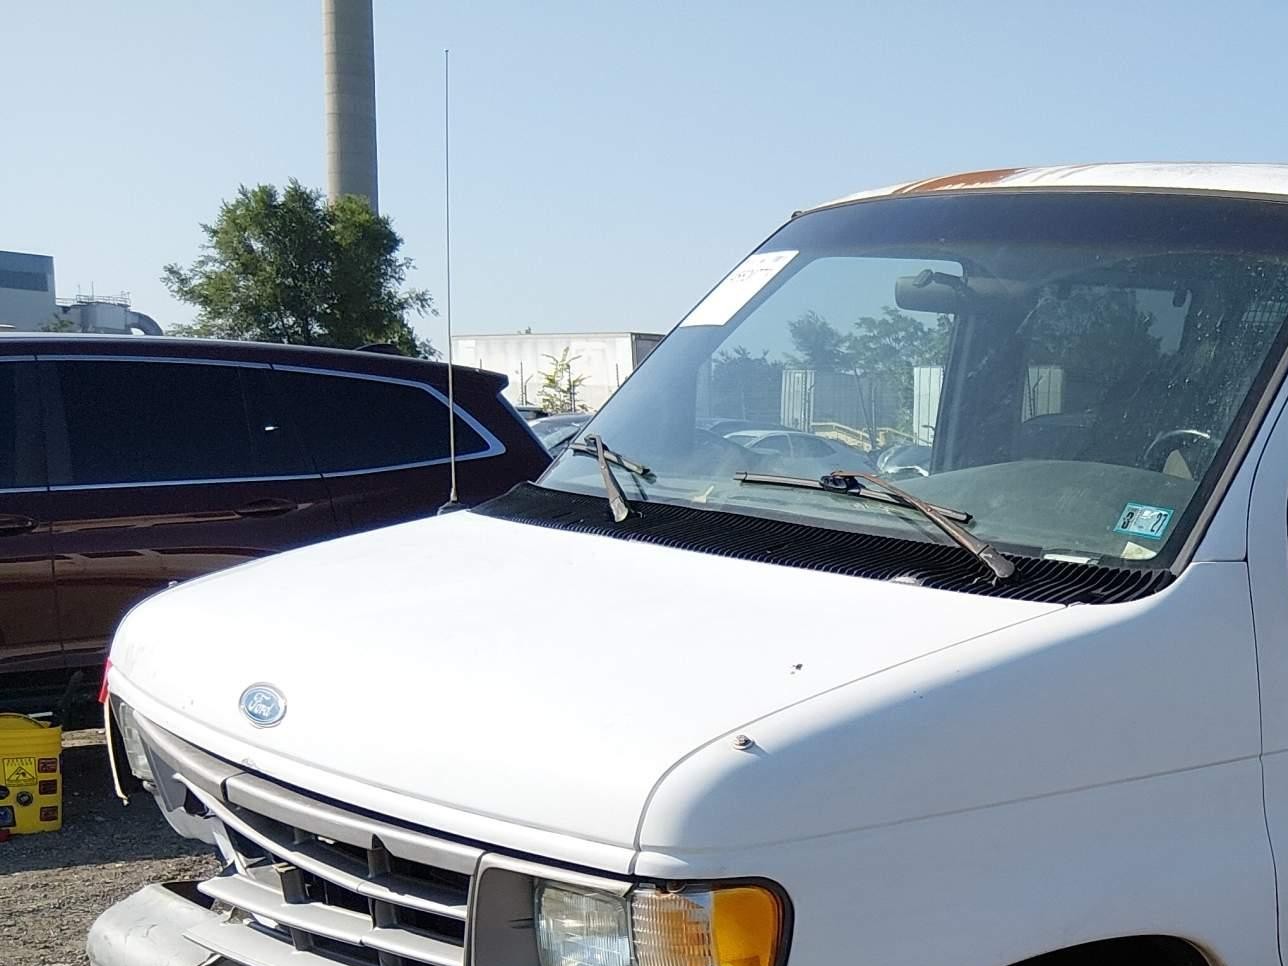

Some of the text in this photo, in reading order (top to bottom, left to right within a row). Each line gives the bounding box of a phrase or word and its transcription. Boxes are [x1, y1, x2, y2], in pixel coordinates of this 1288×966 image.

[1121, 511, 1168, 535] 3 27
[248, 692, 276, 718] Ford
